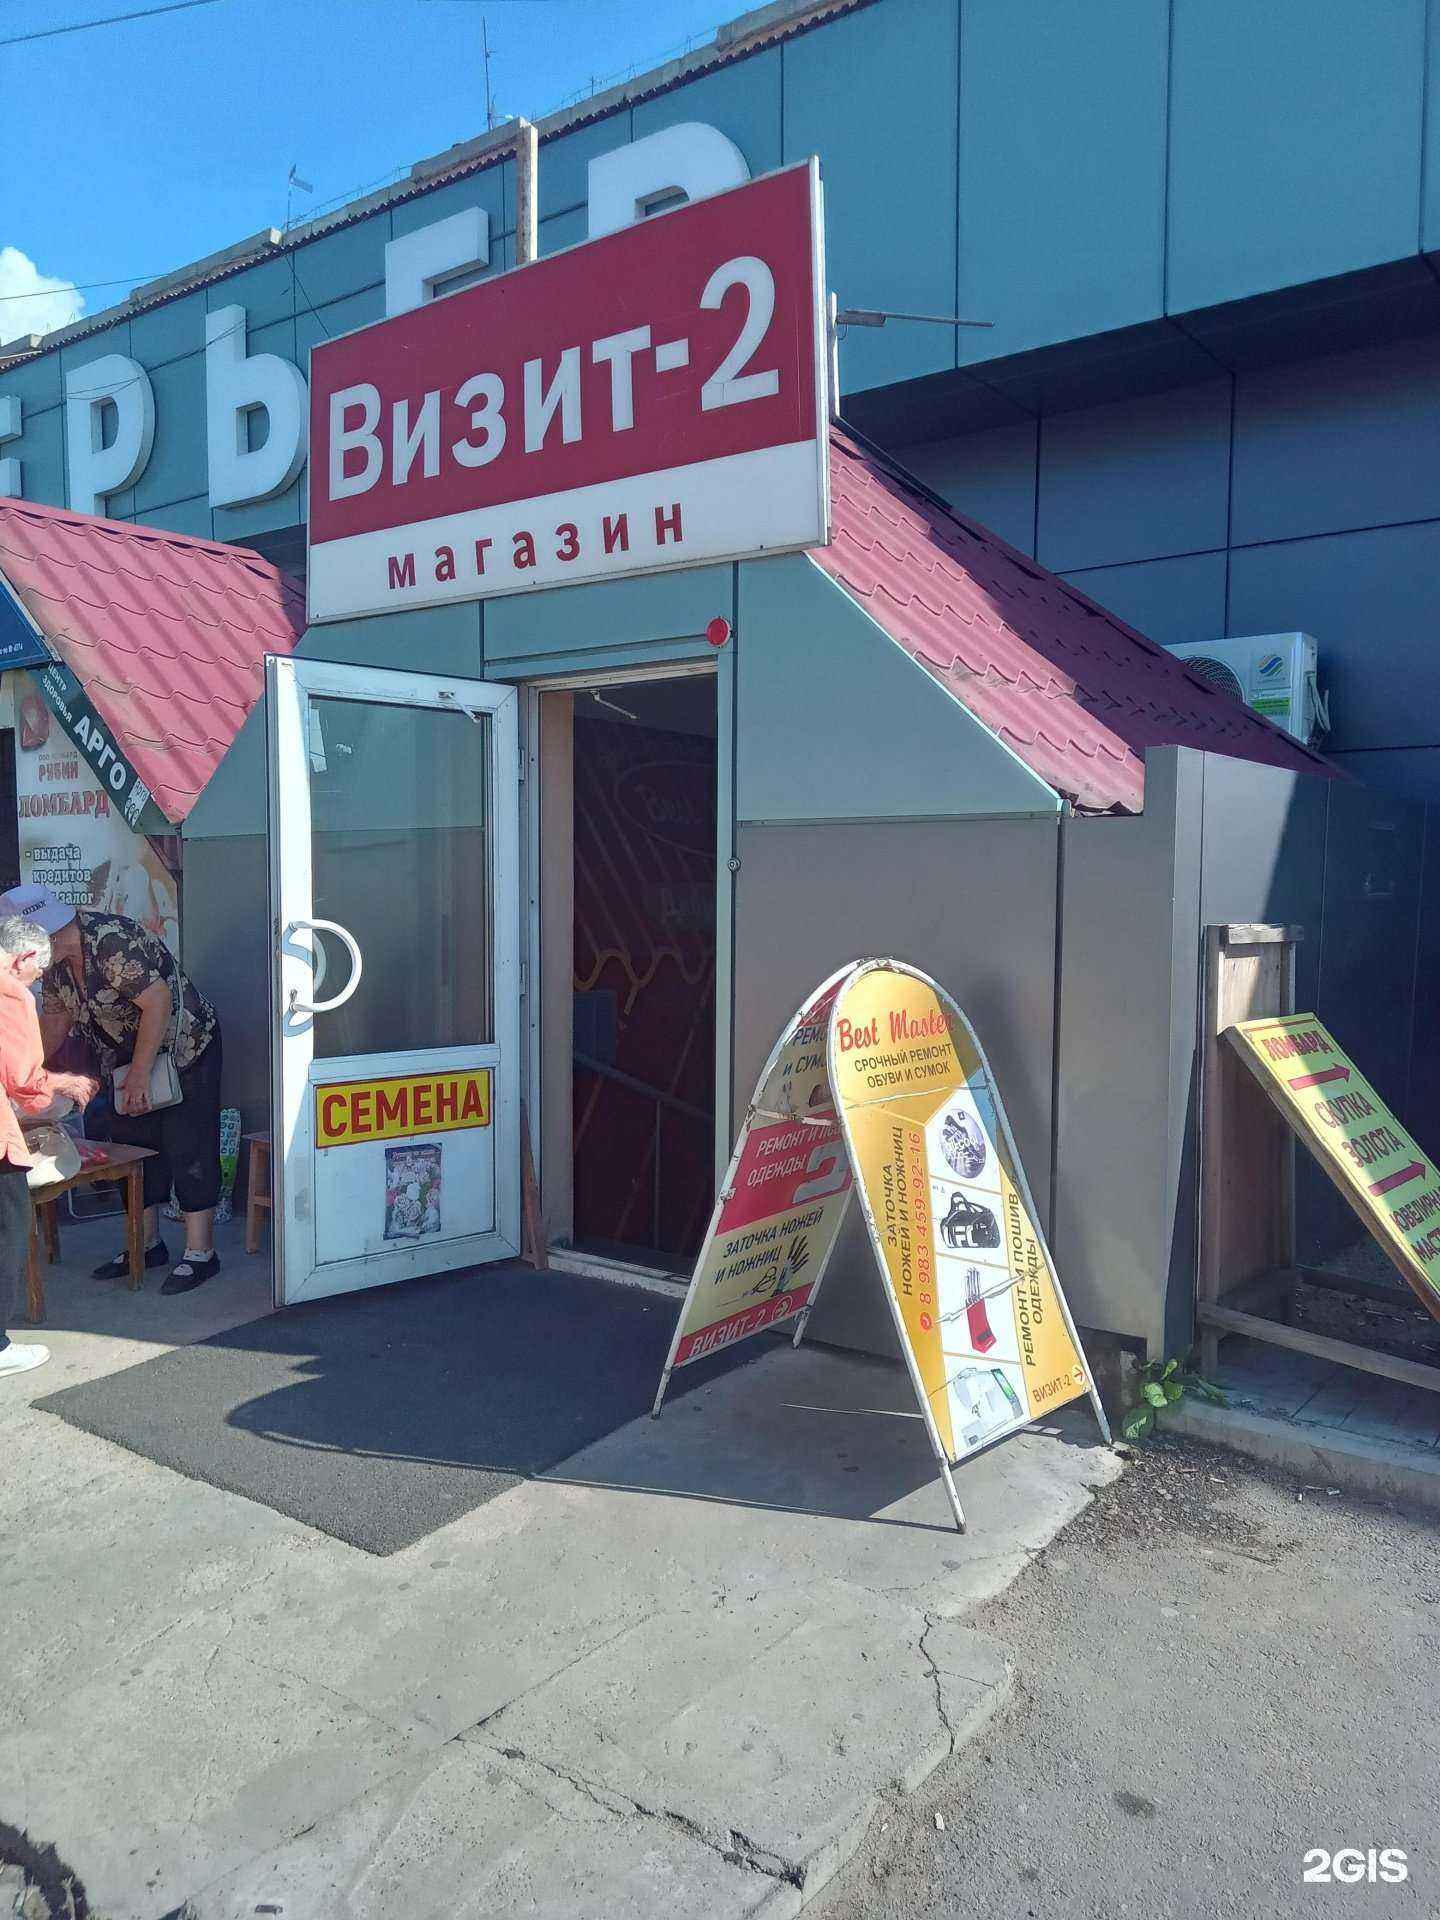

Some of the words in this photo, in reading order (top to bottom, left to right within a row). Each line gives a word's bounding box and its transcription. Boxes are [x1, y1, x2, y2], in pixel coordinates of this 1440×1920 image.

[387, 502, 685, 591] магазин
[48, 662, 68, 691] ЦЕНТР
[41, 675, 73, 724] ЗДОРОВЬЯ
[73, 715, 127, 790] АРГО
[19, 789, 110, 818] ЛОМБАРД
[33, 846, 82, 862] выдача
[32, 869, 92, 885] кредитов
[58, 891, 94, 905] залог
[837, 1017, 880, 1052] Best
[1261, 1030, 1334, 1062] ЛОМБАРД
[795, 1055, 828, 1074] СУМ
[854, 1048, 908, 1072] СРОЧНЫЙ
[910, 1043, 953, 1062] РЕМОНТ
[868, 1070, 902, 1088] ОБУВИ
[905, 1069, 914, 1079] И
[914, 1061, 950, 1079] СУМОК
[322, 1079, 484, 1138] СЕМЕНА
[1314, 1091, 1377, 1129] СКУПКА
[756, 1128, 809, 1158] РЕМОНТ
[1341, 1126, 1406, 1168] ЗОЛОТА
[747, 1154, 807, 1186] ОДЕЖДЫ
[892, 1126, 907, 1205] НОЖНИЦ
[909, 1133, 928, 1238] 459-92-16
[882, 1164, 898, 1247] ЗАТОЧКА
[899, 1211, 908, 1222] И
[723, 1230, 777, 1258] ЗАТОЧКА
[778, 1207, 824, 1238] НОЖЕЙ
[1008, 1192, 1025, 1264] ПОШИВ
[714, 1269, 726, 1285] И
[726, 1246, 783, 1278] НОЖНИЦ
[897, 1226, 912, 1296] НОЖЕЙ
[916, 1245, 931, 1284] 983
[919, 1293, 932, 1305] 8
[1025, 1238, 1043, 1325] ОДЕЖДЫ
[688, 1309, 766, 1357] ВИЗИТ-2
[1016, 1284, 1036, 1367] РЕМОНТ
[1032, 1374, 1072, 1403] ВИЗИТ-2
